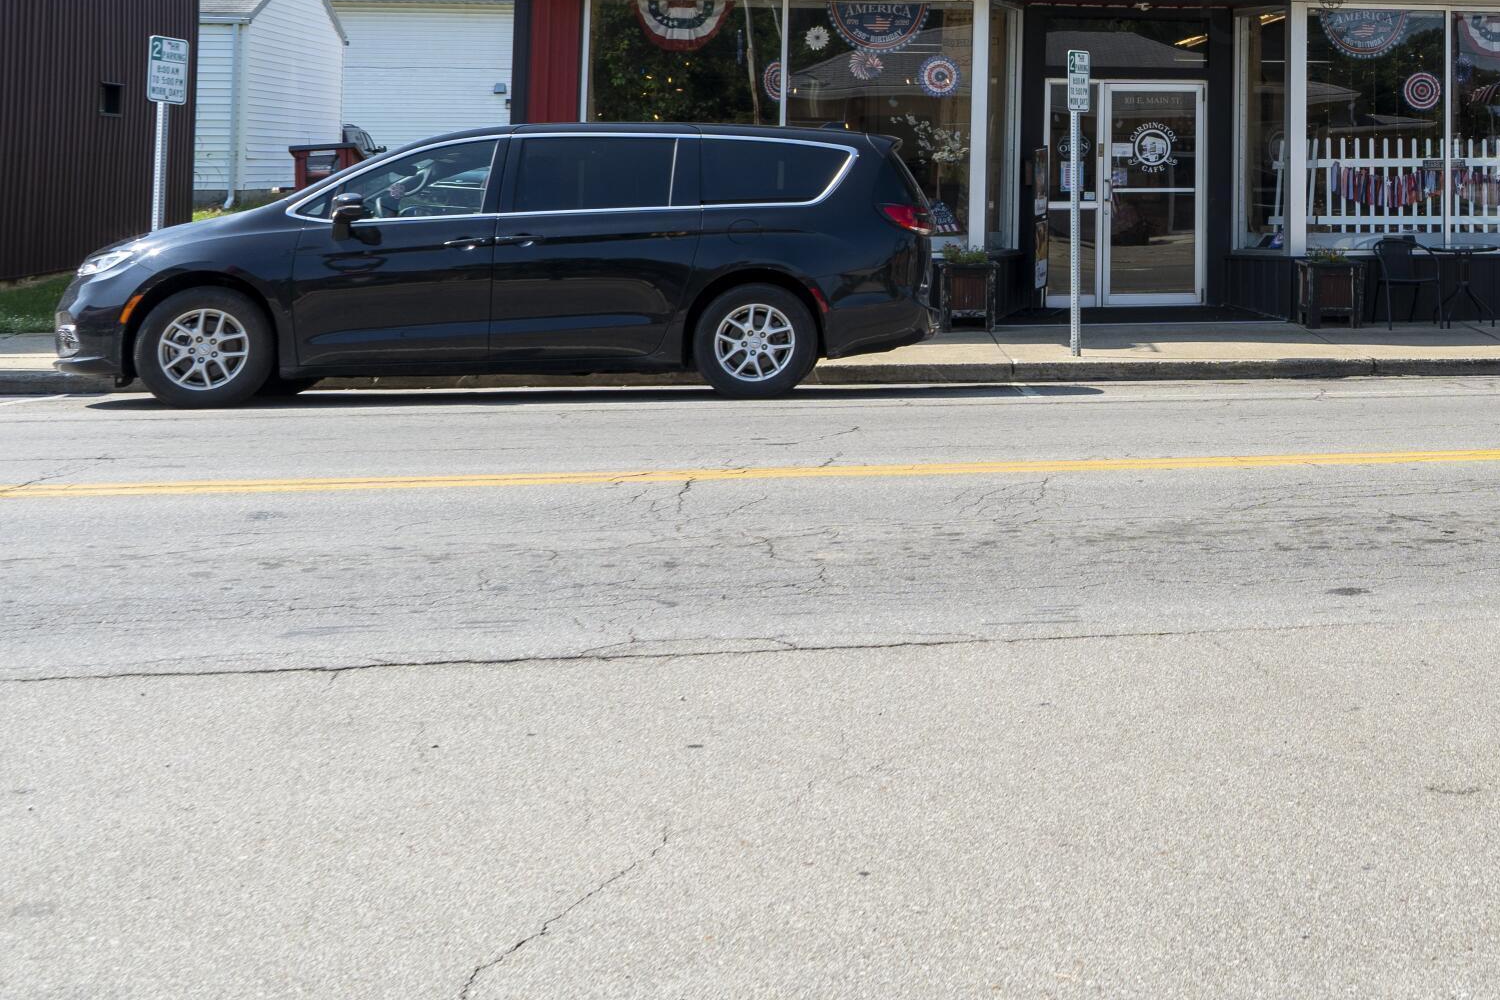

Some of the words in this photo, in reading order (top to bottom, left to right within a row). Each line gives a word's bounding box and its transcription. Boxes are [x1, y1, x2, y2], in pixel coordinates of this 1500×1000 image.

[845, 3, 911, 19] AMERICA
[1334, 11, 1392, 25] AMERICA
[153, 41, 161, 57] 2
[1069, 55, 1075, 70] 2
[1146, 96, 1169, 104] MAIN
[1129, 121, 1178, 143] CARDINGTON
[1141, 164, 1165, 173] CAFE
